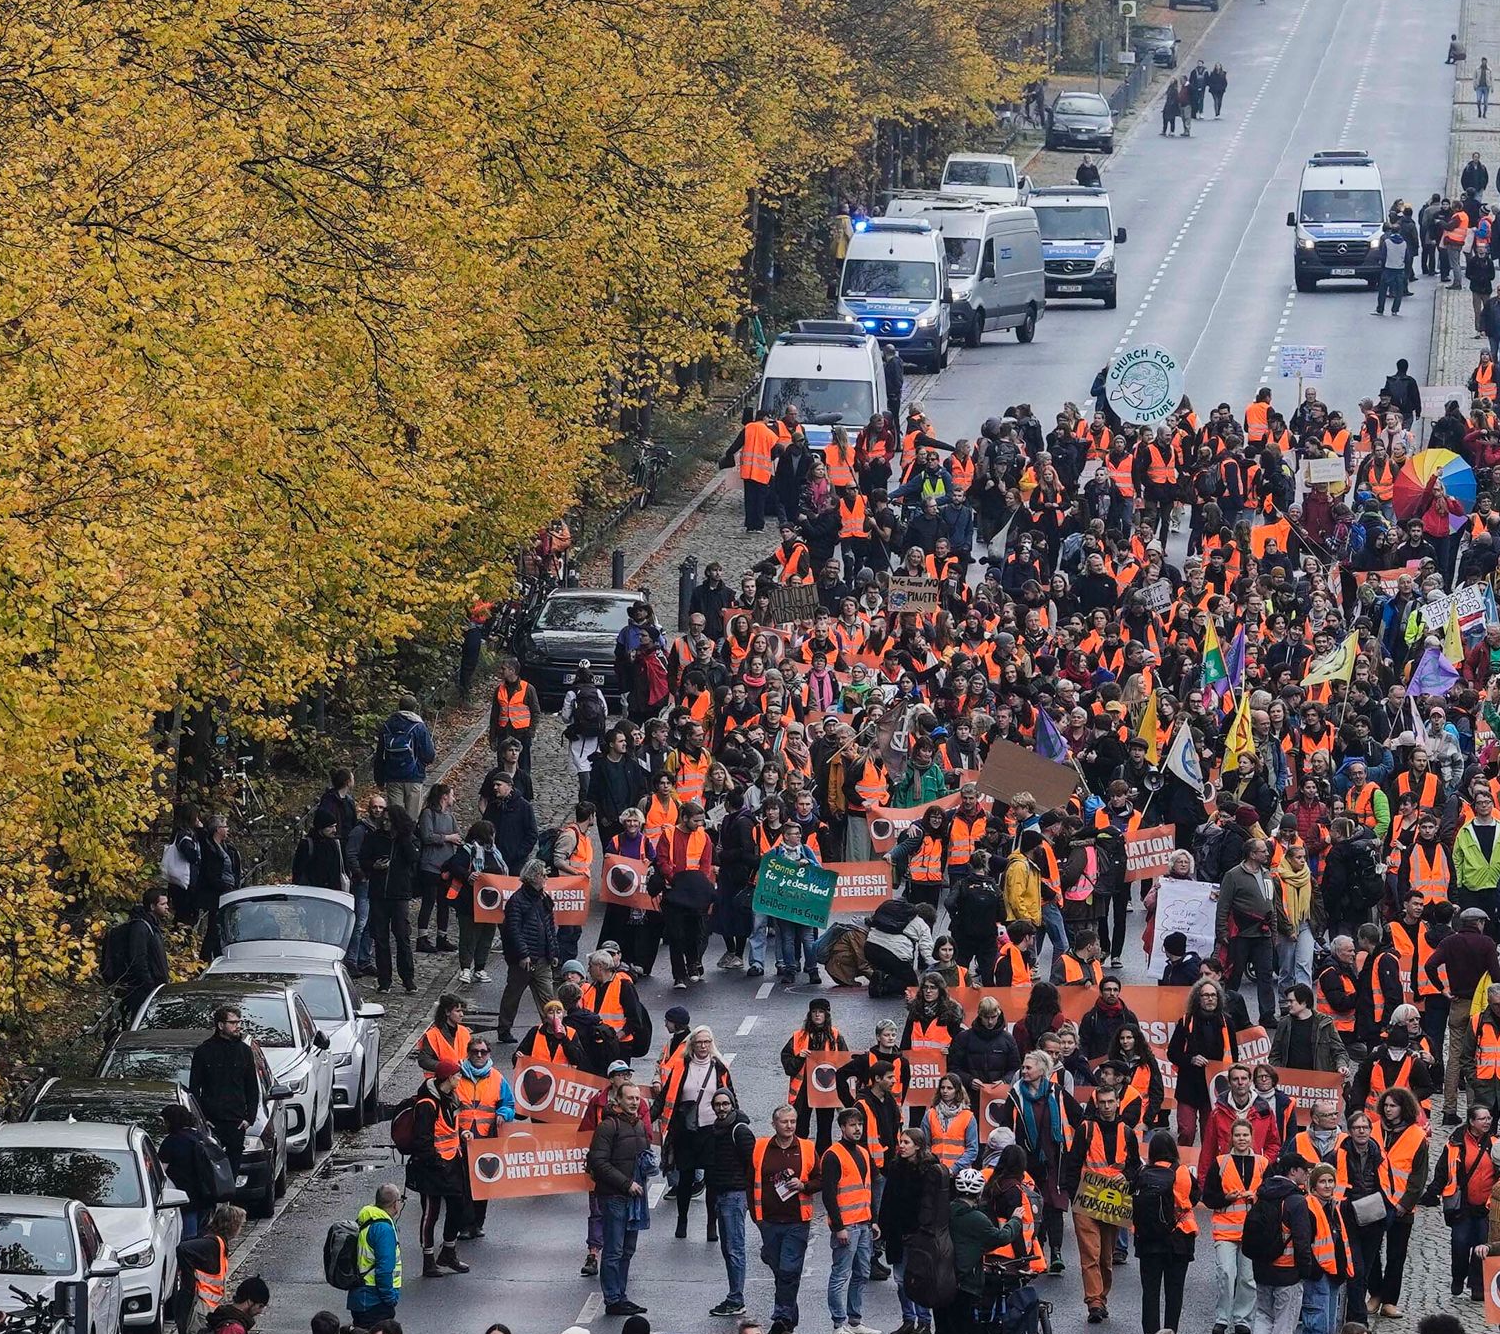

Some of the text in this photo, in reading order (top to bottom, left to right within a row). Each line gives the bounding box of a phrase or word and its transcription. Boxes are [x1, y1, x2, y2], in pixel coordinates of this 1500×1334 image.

[1110, 349, 1176, 380] CHURCH FOR
[1135, 399, 1176, 422] FUTURE
[765, 870, 778, 881] für
[768, 859, 796, 876] Sonne
[797, 868, 806, 878] &
[852, 875, 887, 886] FOSSIL
[551, 889, 586, 902] FOSSIL
[840, 886, 888, 897] GERECHT
[909, 1063, 940, 1076] OSSIL
[1277, 1085, 1339, 1099] VON FOSSIL
[553, 1097, 580, 1115] VOR
[504, 1150, 565, 1165] WEG VON
[506, 1165, 550, 1179] HIN ZU
